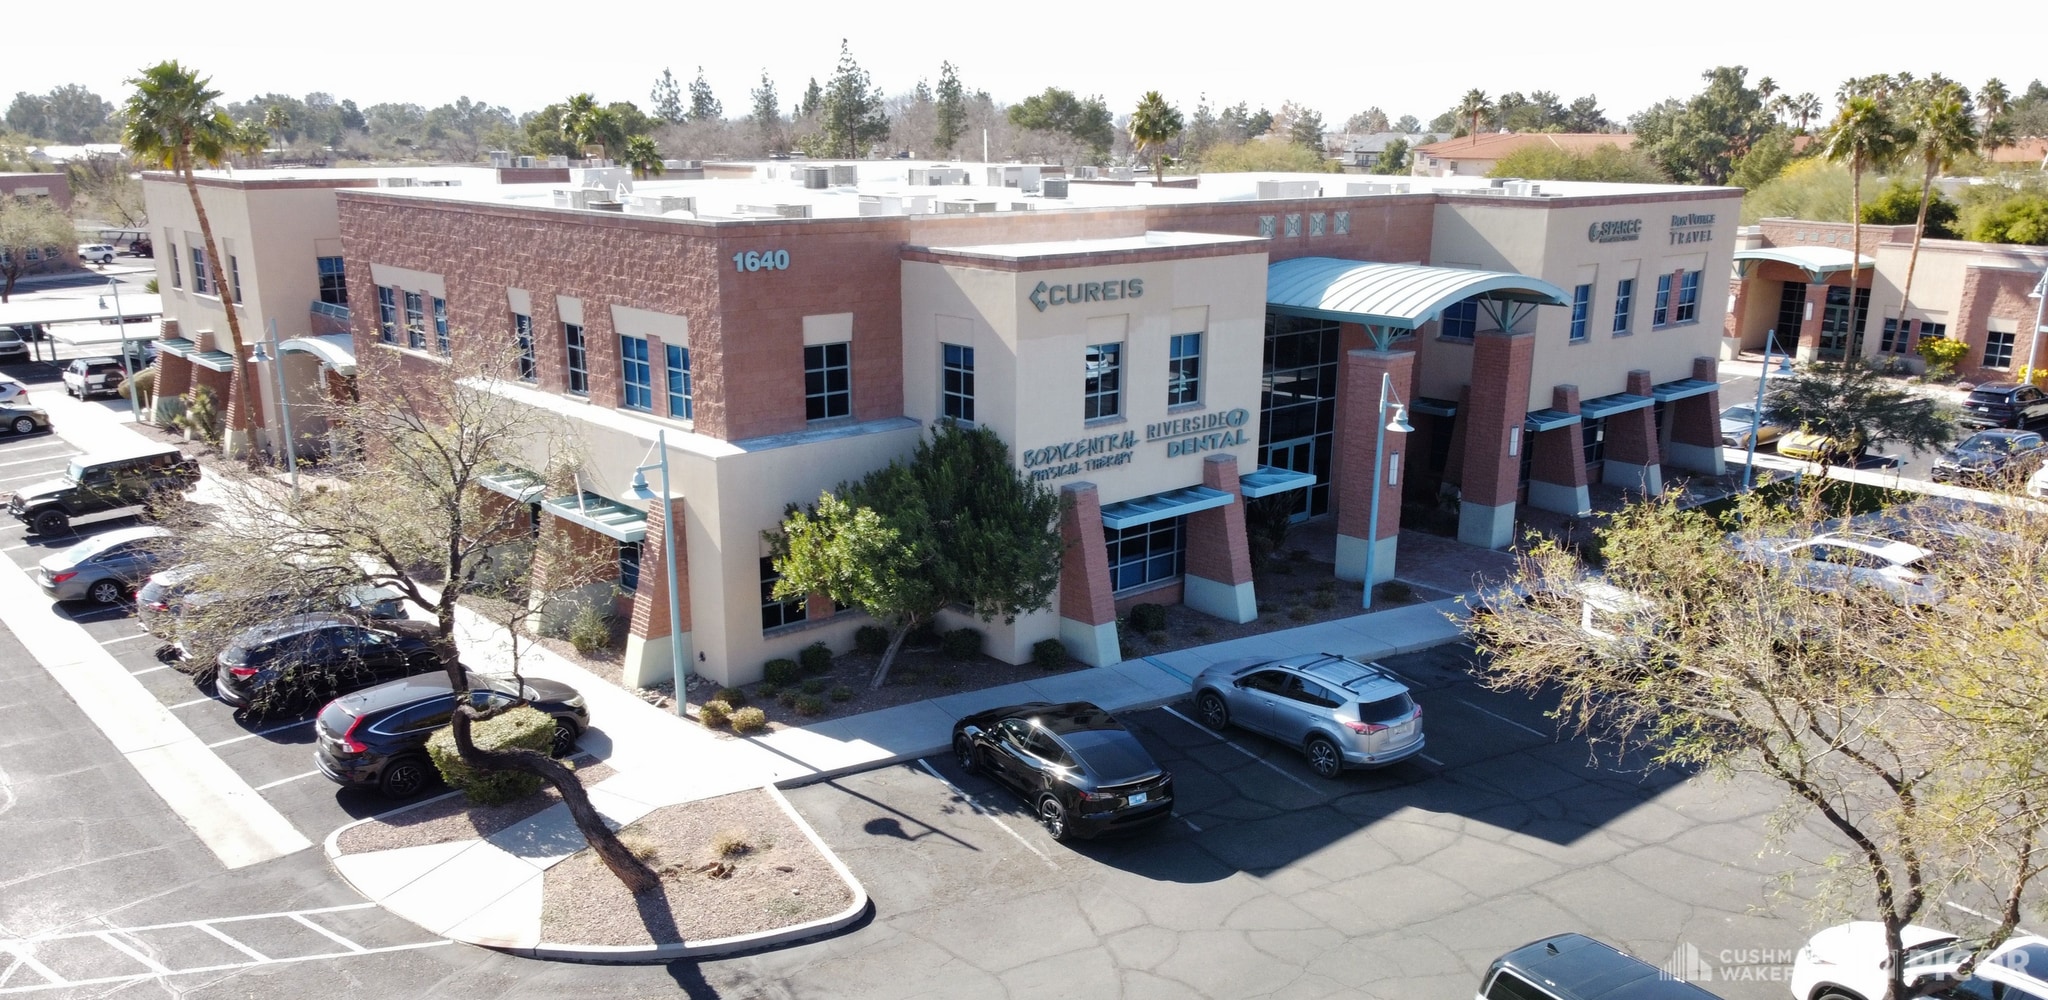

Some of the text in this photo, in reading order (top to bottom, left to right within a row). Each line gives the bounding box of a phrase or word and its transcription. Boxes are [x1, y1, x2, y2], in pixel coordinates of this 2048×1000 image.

[1601, 218, 1642, 235] SPARCC
[1669, 230, 1713, 245] TRAVEL
[732, 249, 790, 273] 1640
[1049, 278, 1144, 306] CUREIS
[1146, 411, 1227, 439] RIVERSIDE
[1023, 430, 1140, 469] BODYCENTRAL
[1167, 429, 1248, 458] DENTAL
[1031, 451, 1134, 482] PHYSICAL THERAPY
